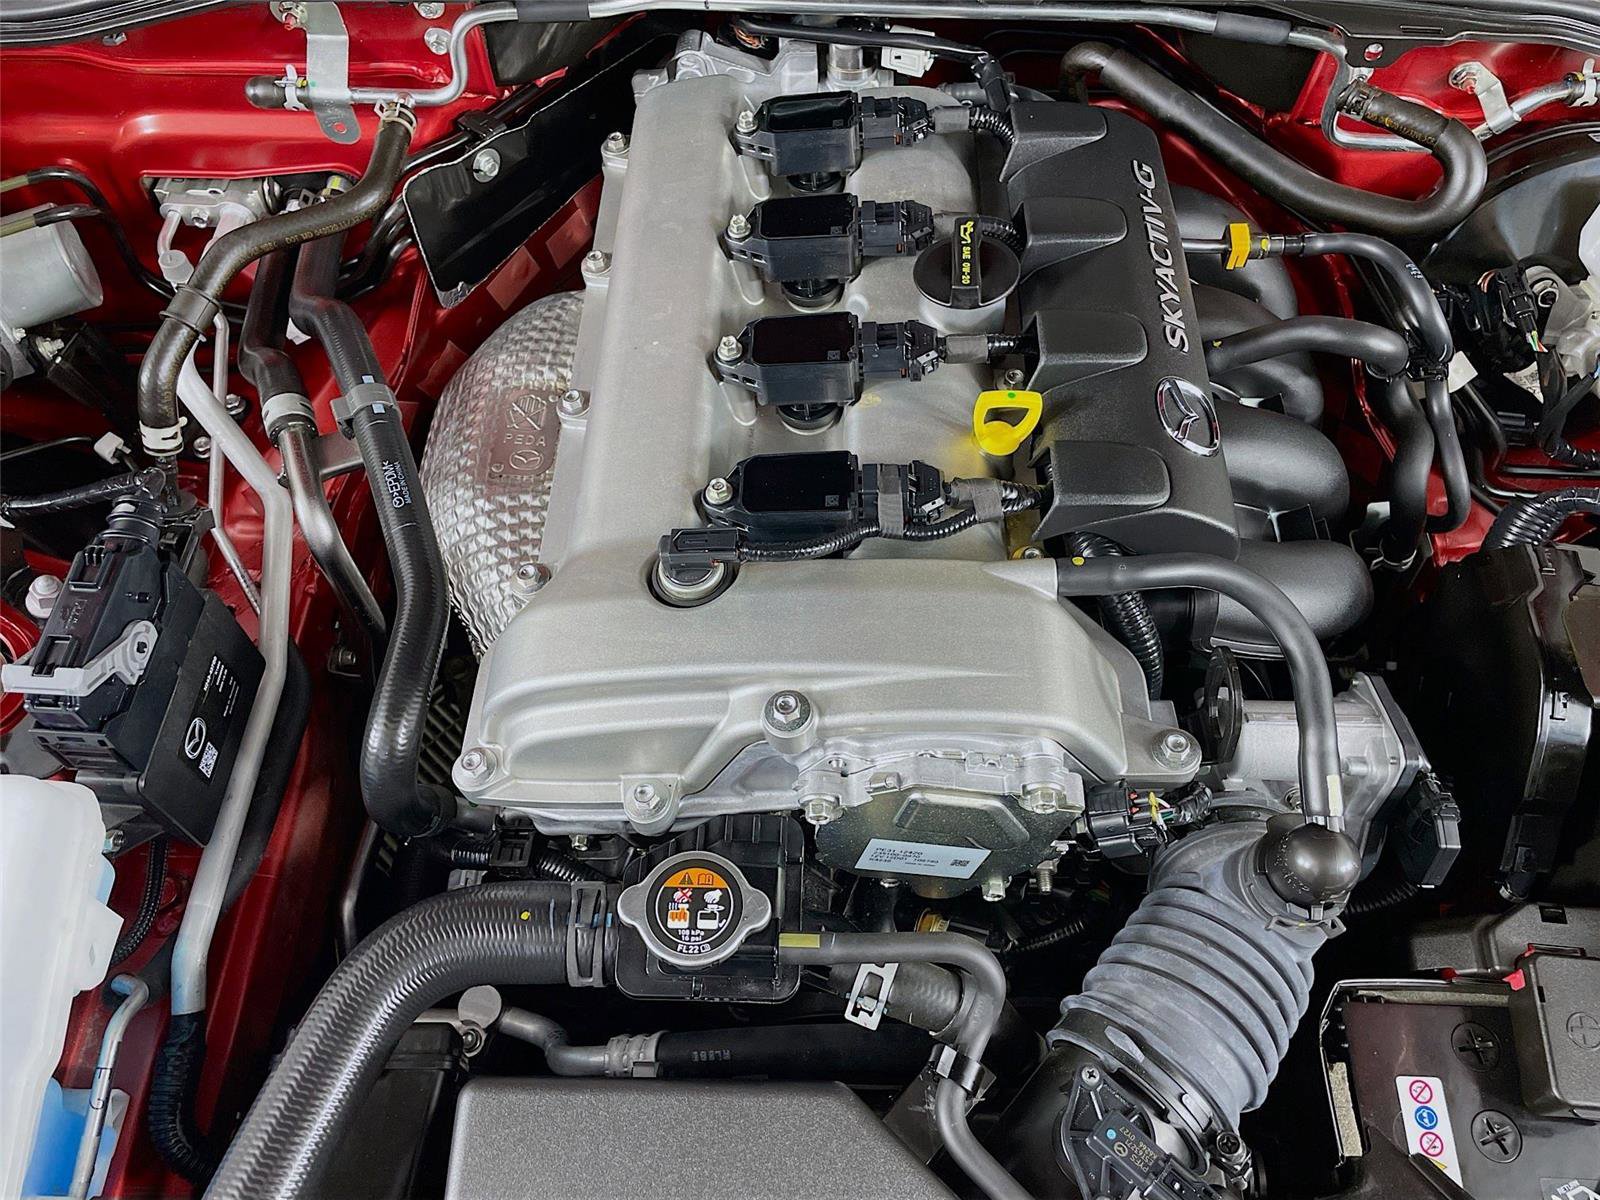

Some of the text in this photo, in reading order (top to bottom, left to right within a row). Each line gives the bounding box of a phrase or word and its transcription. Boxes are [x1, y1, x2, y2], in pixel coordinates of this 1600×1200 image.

[961, 246, 971, 285] SAE 0W-20
[1132, 160, 1189, 354] SKYACTIV-G
[503, 433, 546, 447] PEDA
[393, 461, 405, 480] CHINA
[401, 486, 412, 504] MADE
[676, 943, 700, 954] FL22
[1129, 1153, 1150, 1173] PYFS
